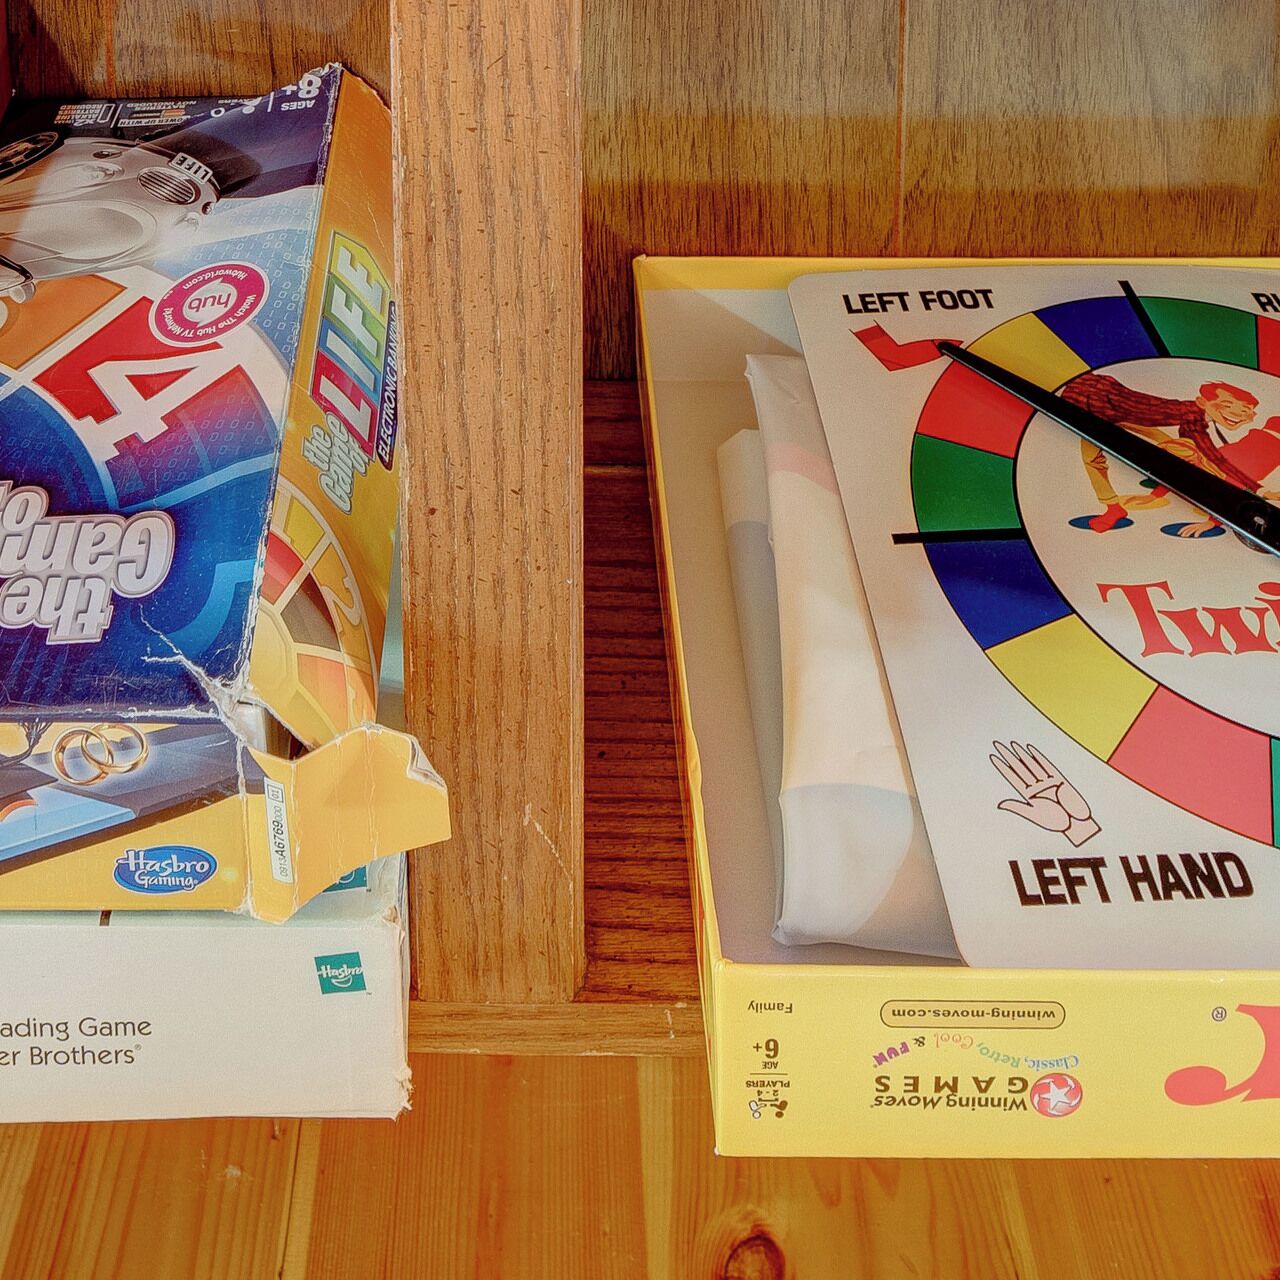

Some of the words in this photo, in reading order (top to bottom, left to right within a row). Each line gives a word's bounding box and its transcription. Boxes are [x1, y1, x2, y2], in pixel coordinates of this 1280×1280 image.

[176, 154, 210, 181] LIFE
[188, 292, 233, 314] hub
[841, 291, 910, 316] LEFT
[918, 289, 995, 313] FOOT
[318, 246, 384, 442] LIFE
[302, 423, 334, 468] the
[318, 411, 353, 515] Game
[1, 573, 116, 644] the
[116, 849, 211, 878] Hasbro
[134, 870, 196, 888] Gaming
[1008, 857, 1113, 908] LEFT
[1119, 851, 1254, 901] HAND
[317, 964, 366, 982] Hasbro
[747, 1001, 793, 1016] Family
[891, 1007, 1056, 1021] winning-moves.com
[78, 1017, 153, 1038] Game
[29, 1046, 135, 1067] Brothers
[752, 1037, 780, 1059] 6+
[874, 1074, 1030, 1095] GAMES
[873, 1093, 943, 1110] Moves
[945, 1092, 1029, 1112] Winning
